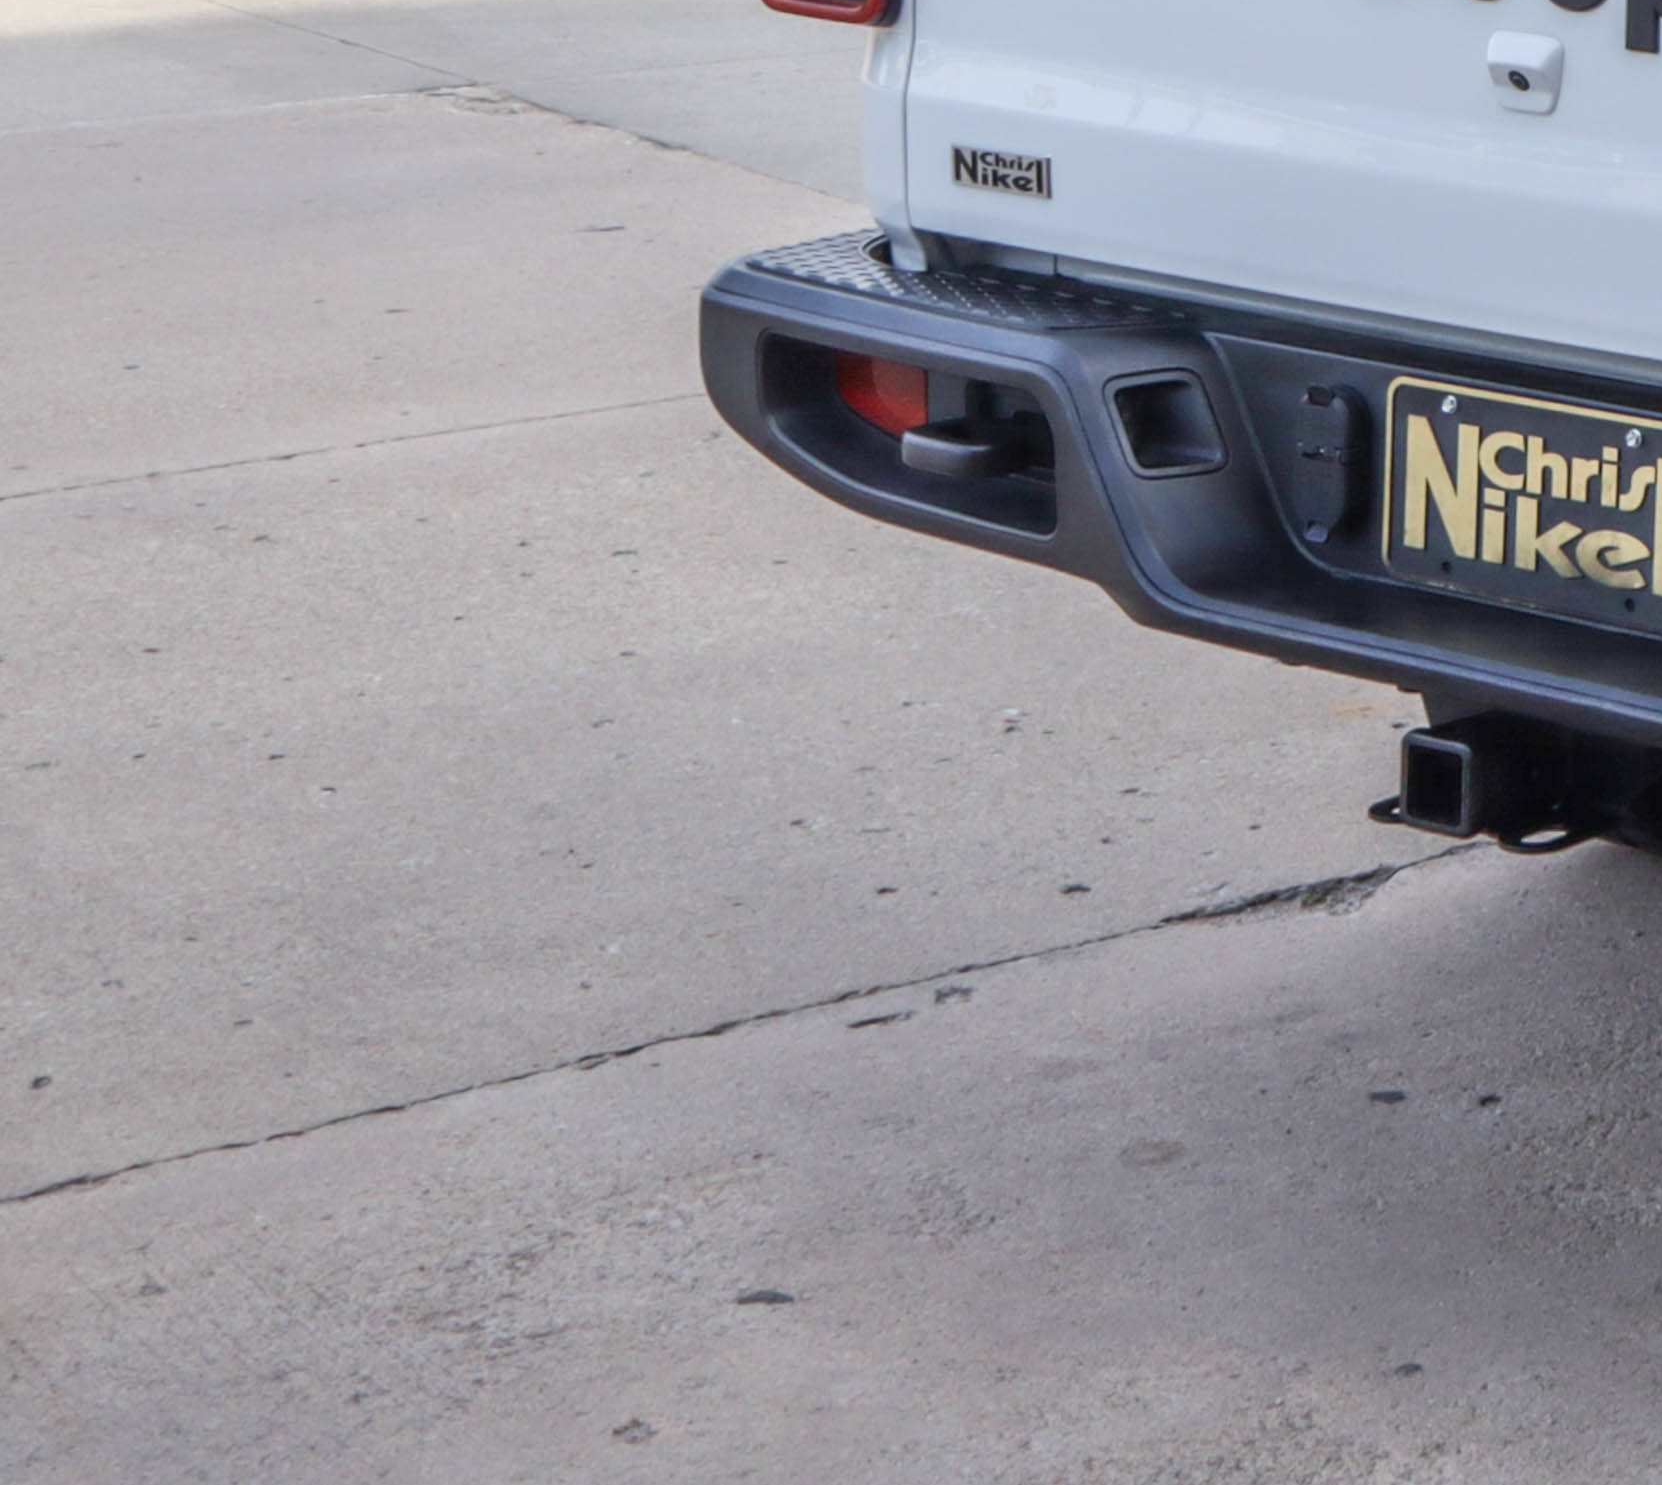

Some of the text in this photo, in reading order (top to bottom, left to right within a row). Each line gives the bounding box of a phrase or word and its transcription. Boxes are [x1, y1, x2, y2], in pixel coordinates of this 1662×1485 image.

[953, 146, 1044, 195] Nikel
[979, 151, 1036, 173] Chris
[1479, 430, 1657, 512] Chris
